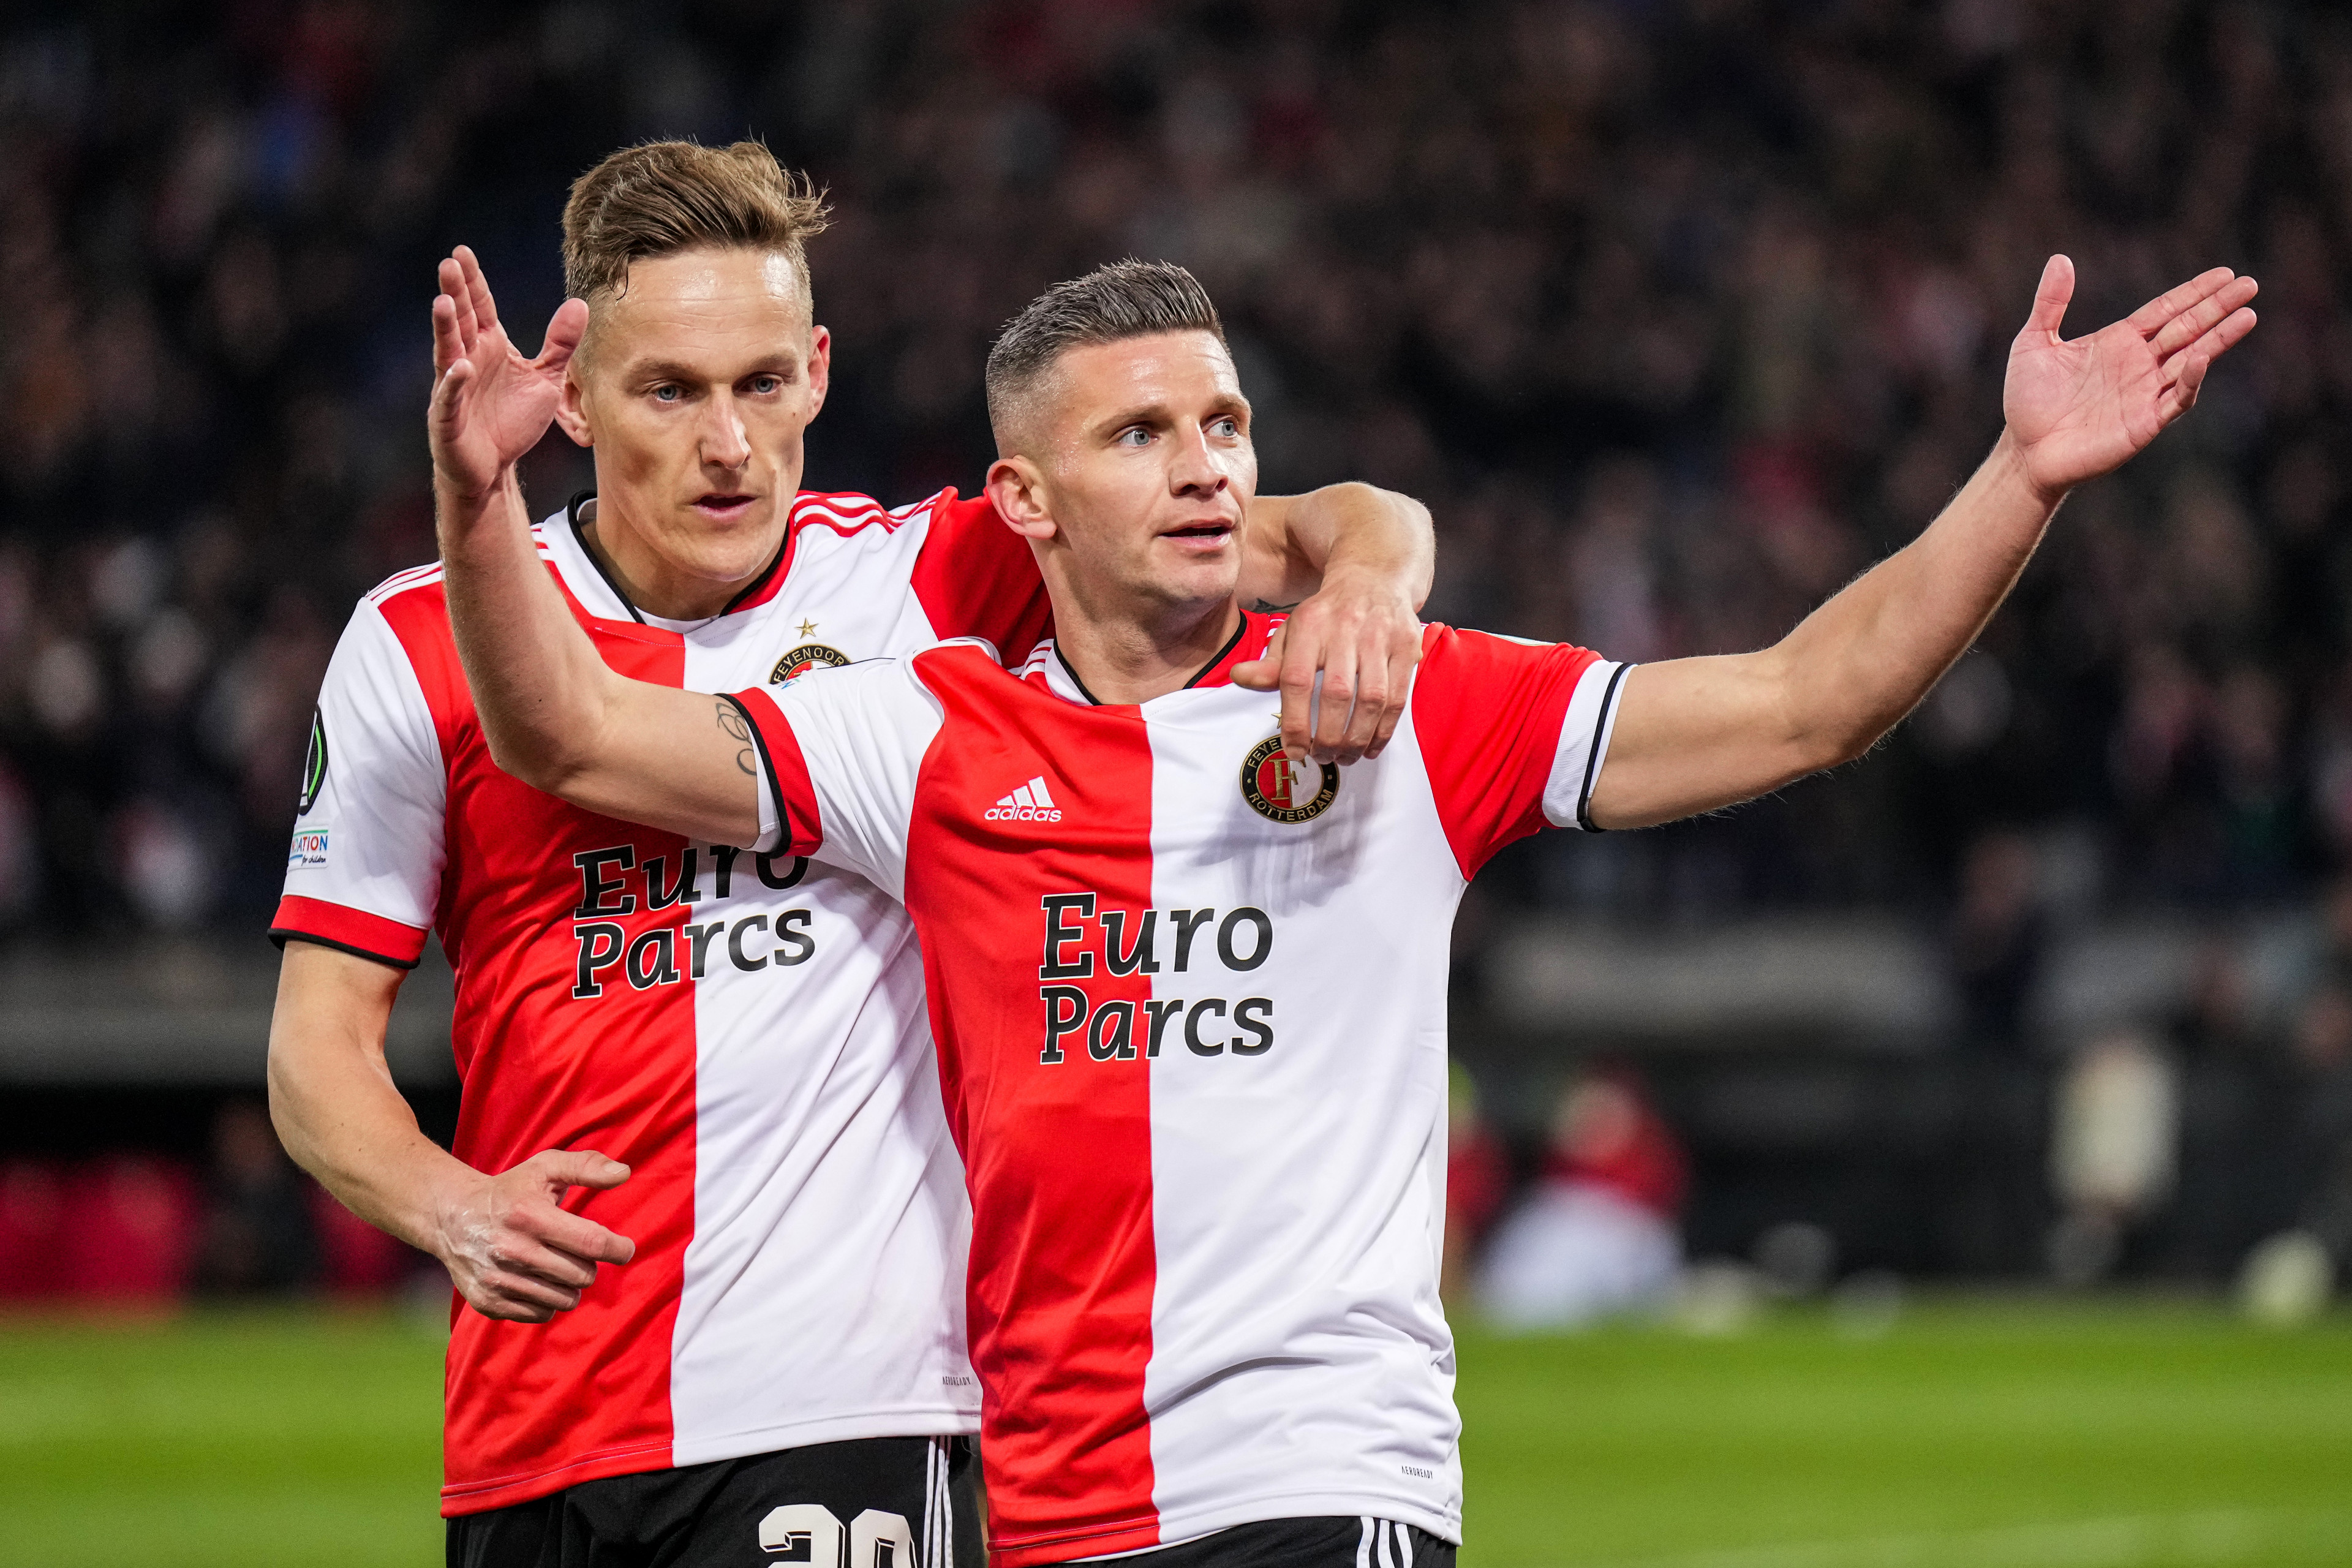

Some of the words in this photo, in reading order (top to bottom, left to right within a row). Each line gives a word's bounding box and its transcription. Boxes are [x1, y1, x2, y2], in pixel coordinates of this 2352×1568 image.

[773, 647, 845, 683] FEYENOOR
[984, 804, 1062, 823] adidas
[1248, 788, 1333, 821] ROTTERDAM
[308, 854, 326, 864] children
[573, 843, 810, 921] Euro
[1039, 891, 1274, 981] Euro
[572, 908, 816, 1000] Parcs
[1039, 984, 1275, 1066] Parcs
[942, 1376, 971, 1386] AEROREADY
[1401, 1465, 1433, 1479] AEROREADY
